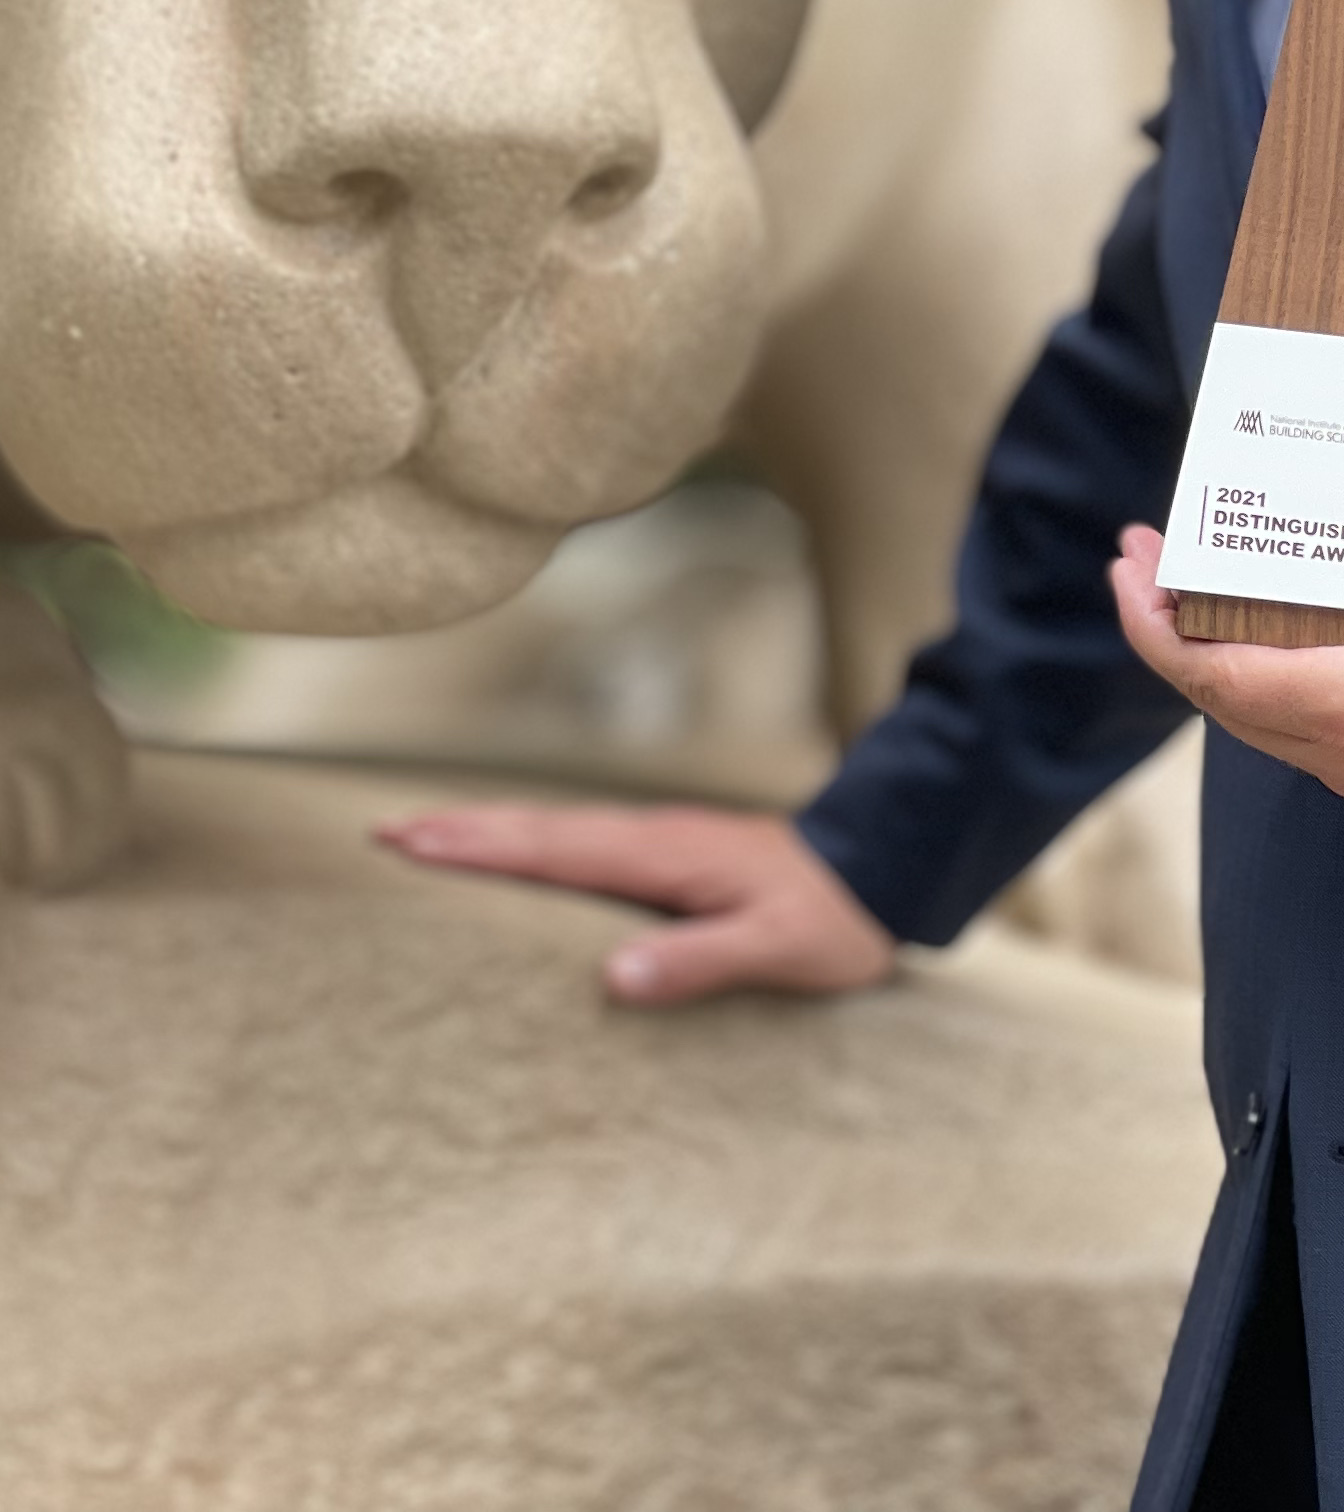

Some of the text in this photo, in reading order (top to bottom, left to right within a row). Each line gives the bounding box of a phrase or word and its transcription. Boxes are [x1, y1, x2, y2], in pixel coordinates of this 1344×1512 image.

[1270, 415, 1305, 426] National
[1308, 418, 1341, 430] Institute
[1269, 425, 1324, 441] BUILDING
[1216, 488, 1266, 507] 2021
[1211, 533, 1305, 558] SERVICE
